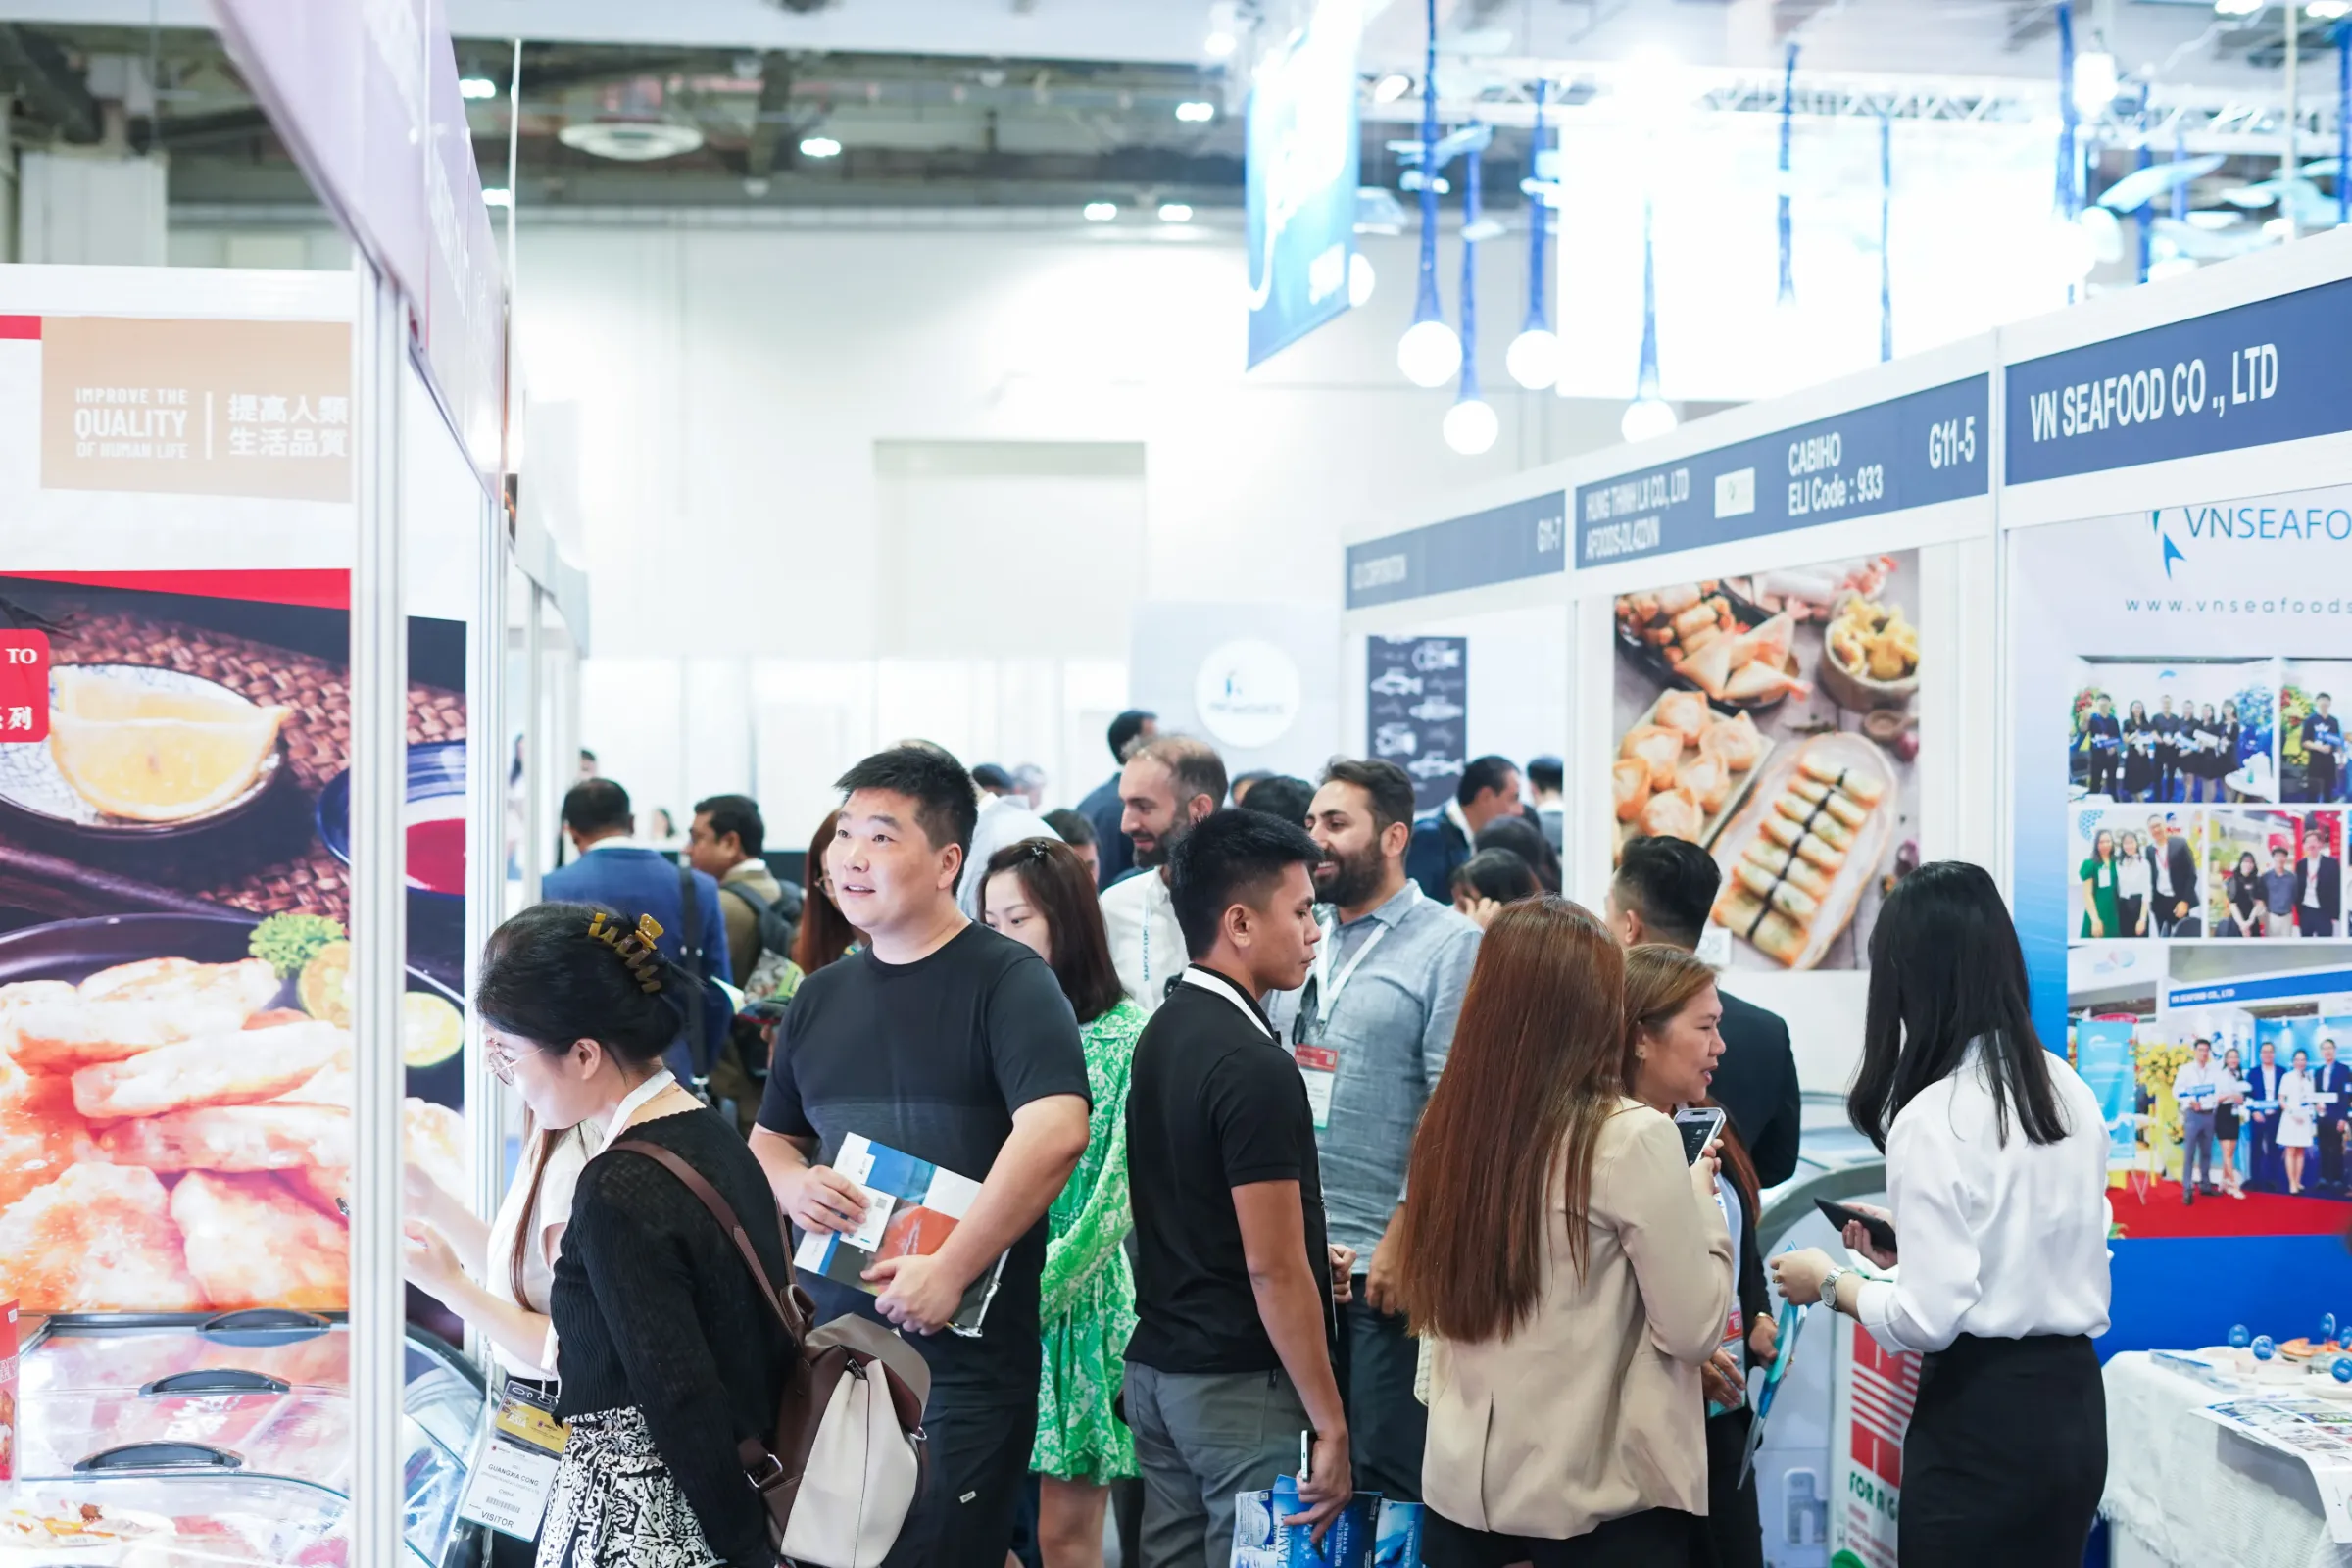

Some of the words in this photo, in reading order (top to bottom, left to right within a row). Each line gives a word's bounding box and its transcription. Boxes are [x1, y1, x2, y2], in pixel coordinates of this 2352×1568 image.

[75, 387, 148, 404] IMPROVE
[156, 388, 188, 405] THE
[227, 392, 349, 425] 提高人類
[2030, 390, 2057, 442] VN
[2062, 368, 2165, 437] SEAFOOD
[2172, 359, 2206, 416] CO
[2232, 343, 2278, 405] LTD
[74, 408, 187, 440] QUALITY
[77, 442, 96, 458] OF
[100, 442, 152, 459] HUMAN
[157, 443, 188, 459] LIFE
[228, 427, 349, 458] 生活品質
[1788, 431, 1841, 477] CABIHO
[1929, 416, 1976, 469] G11-5
[1671, 467, 1690, 503] LTD
[1812, 473, 1846, 511] Code
[1857, 464, 1884, 503] 933
[2184, 507, 2352, 540] VNSEAFO
[5, 648, 37, 664] TO
[498, 1488, 514, 1498] CHINA
[520, 1475, 539, 1487] CONG
[481, 1511, 514, 1528] VISITOR
